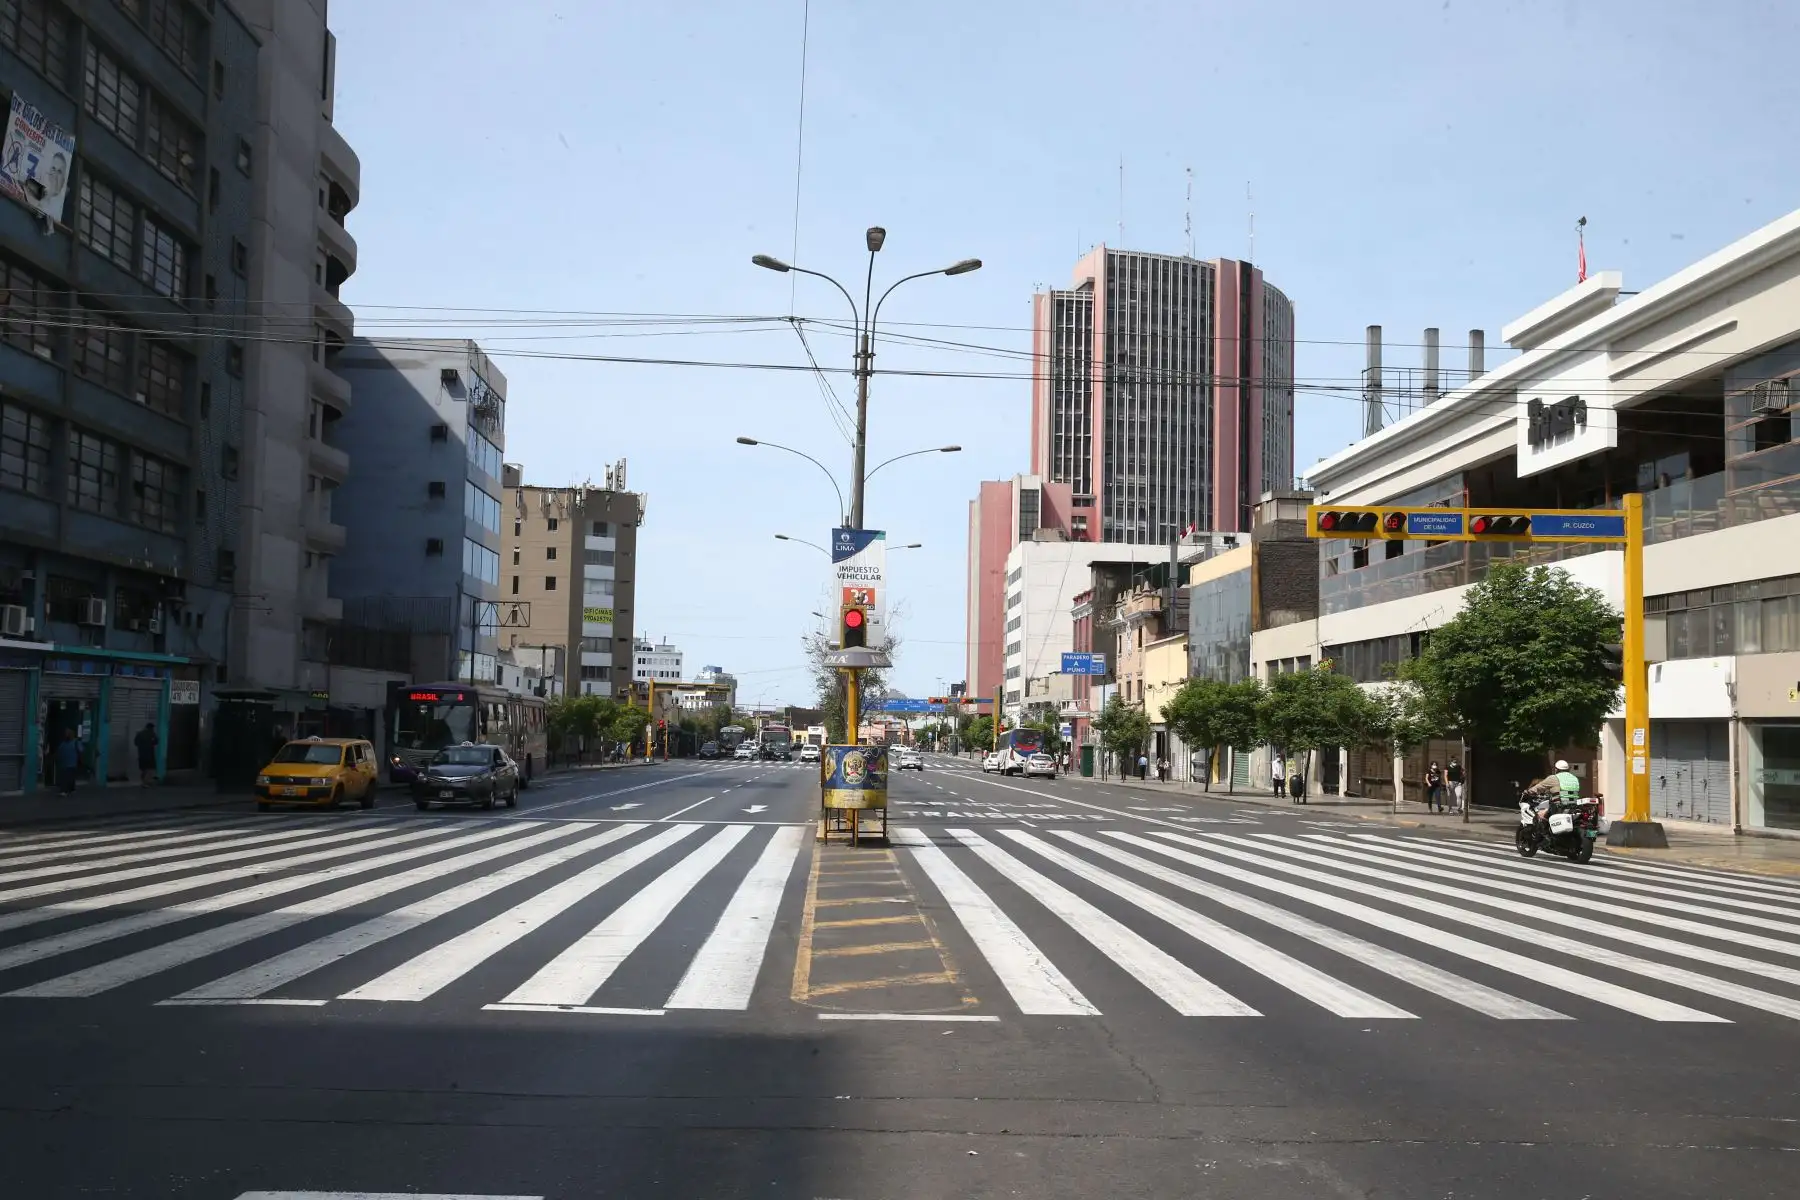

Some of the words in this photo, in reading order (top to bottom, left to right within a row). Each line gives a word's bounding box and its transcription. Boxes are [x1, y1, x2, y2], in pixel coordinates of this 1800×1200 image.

[839, 565, 879, 574] IMPUESTO
[836, 572, 882, 581] VEHICULAR
[410, 693, 438, 701] BRASIL
